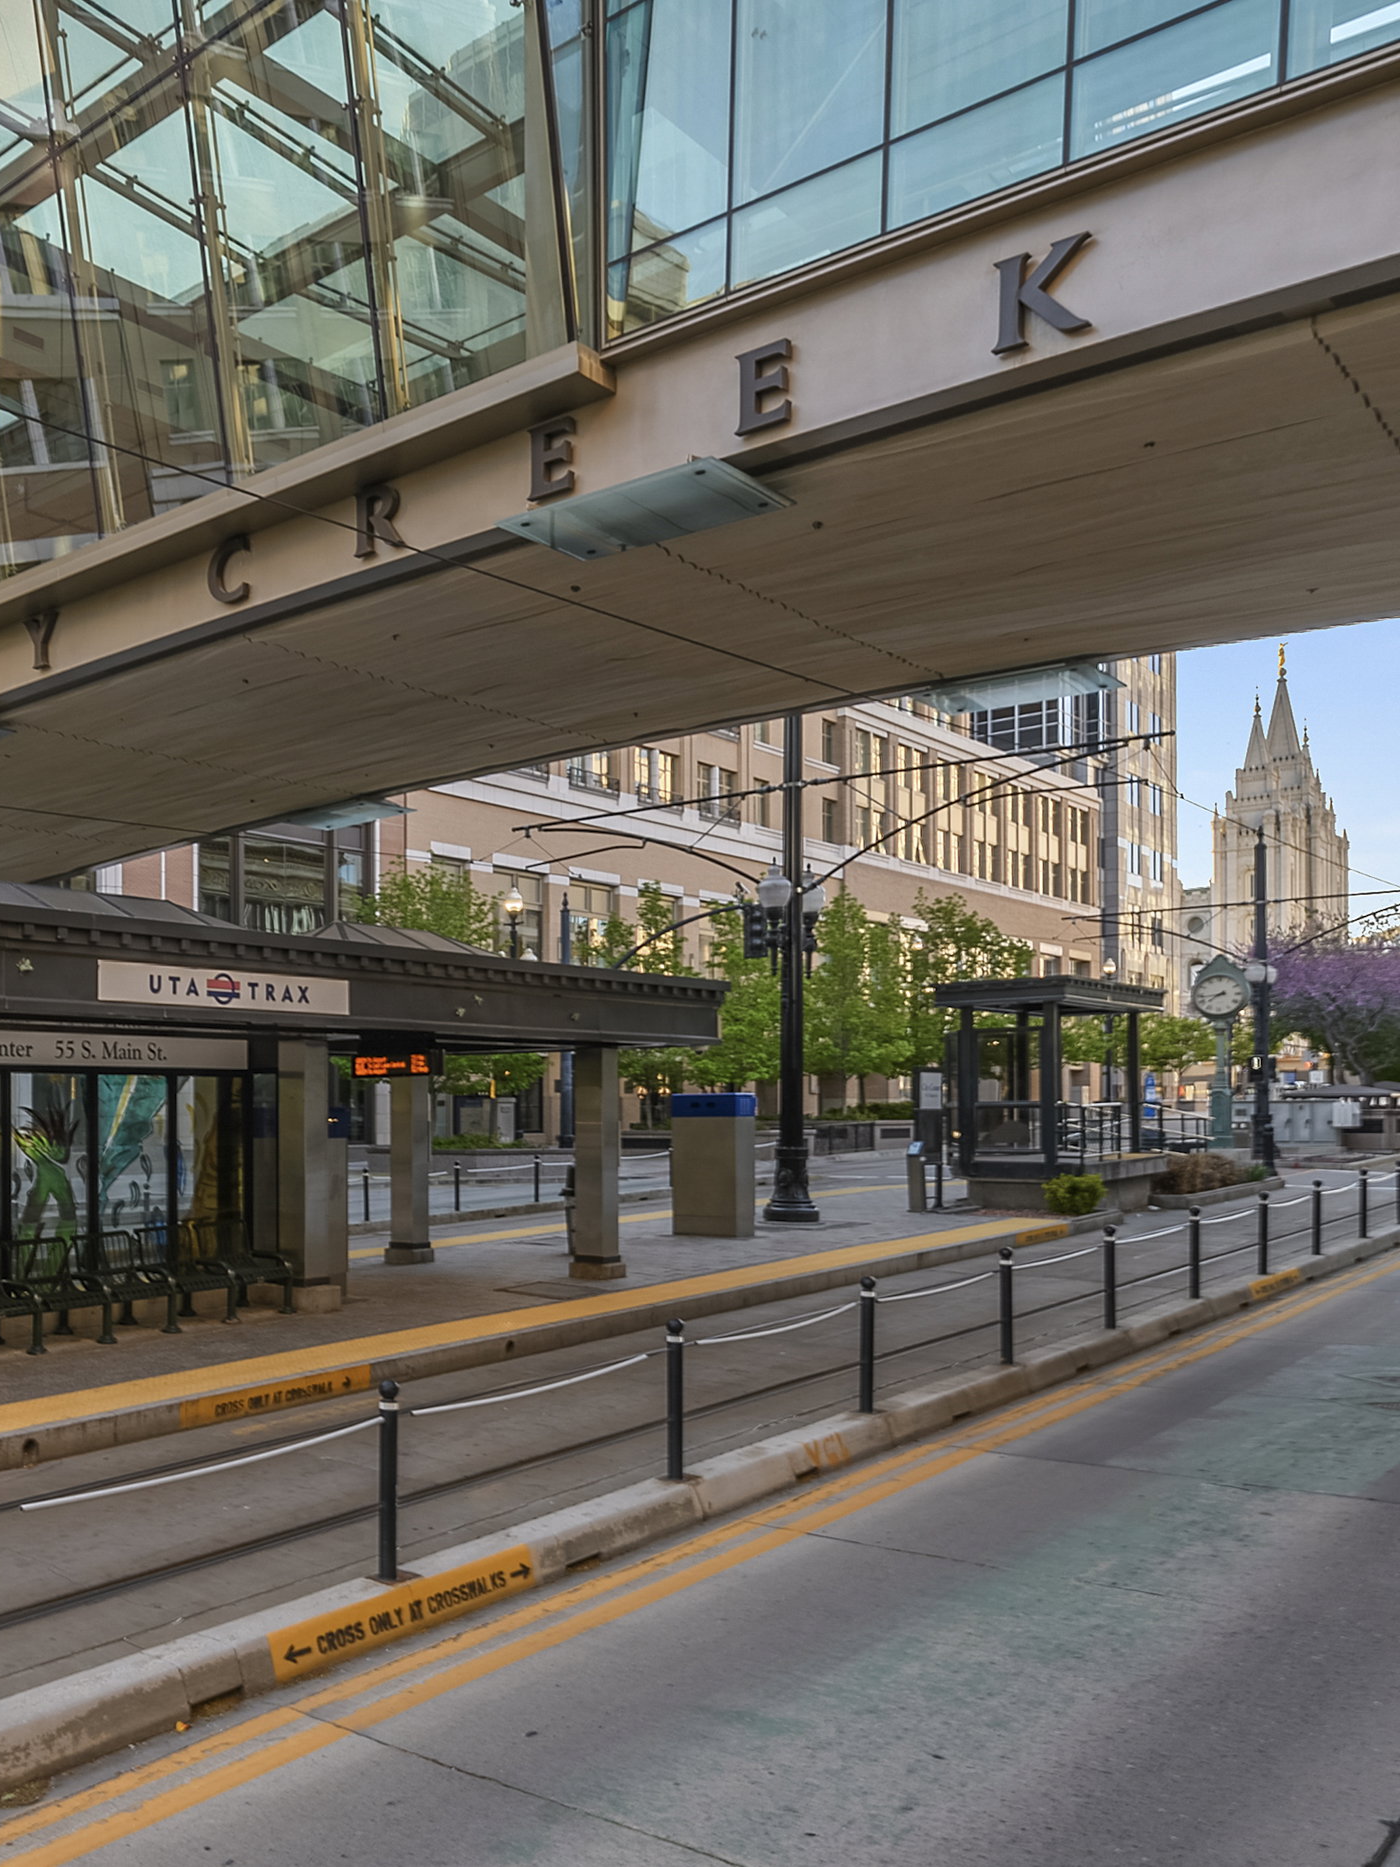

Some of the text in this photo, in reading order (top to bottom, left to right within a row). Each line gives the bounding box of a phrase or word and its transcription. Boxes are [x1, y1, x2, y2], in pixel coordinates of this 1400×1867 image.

[207, 230, 1093, 604] CREEK
[149, 974, 310, 1004] UTA TRAX
[54, 1040, 76, 1059] 55
[80, 1040, 97, 1060] S.
[102, 1041, 144, 1061] Main
[147, 1042, 168, 1061] St.
[214, 1399, 244, 1417] CROSS
[316, 1570, 508, 1655] CROSS ONLY AT CROSSWALKS
